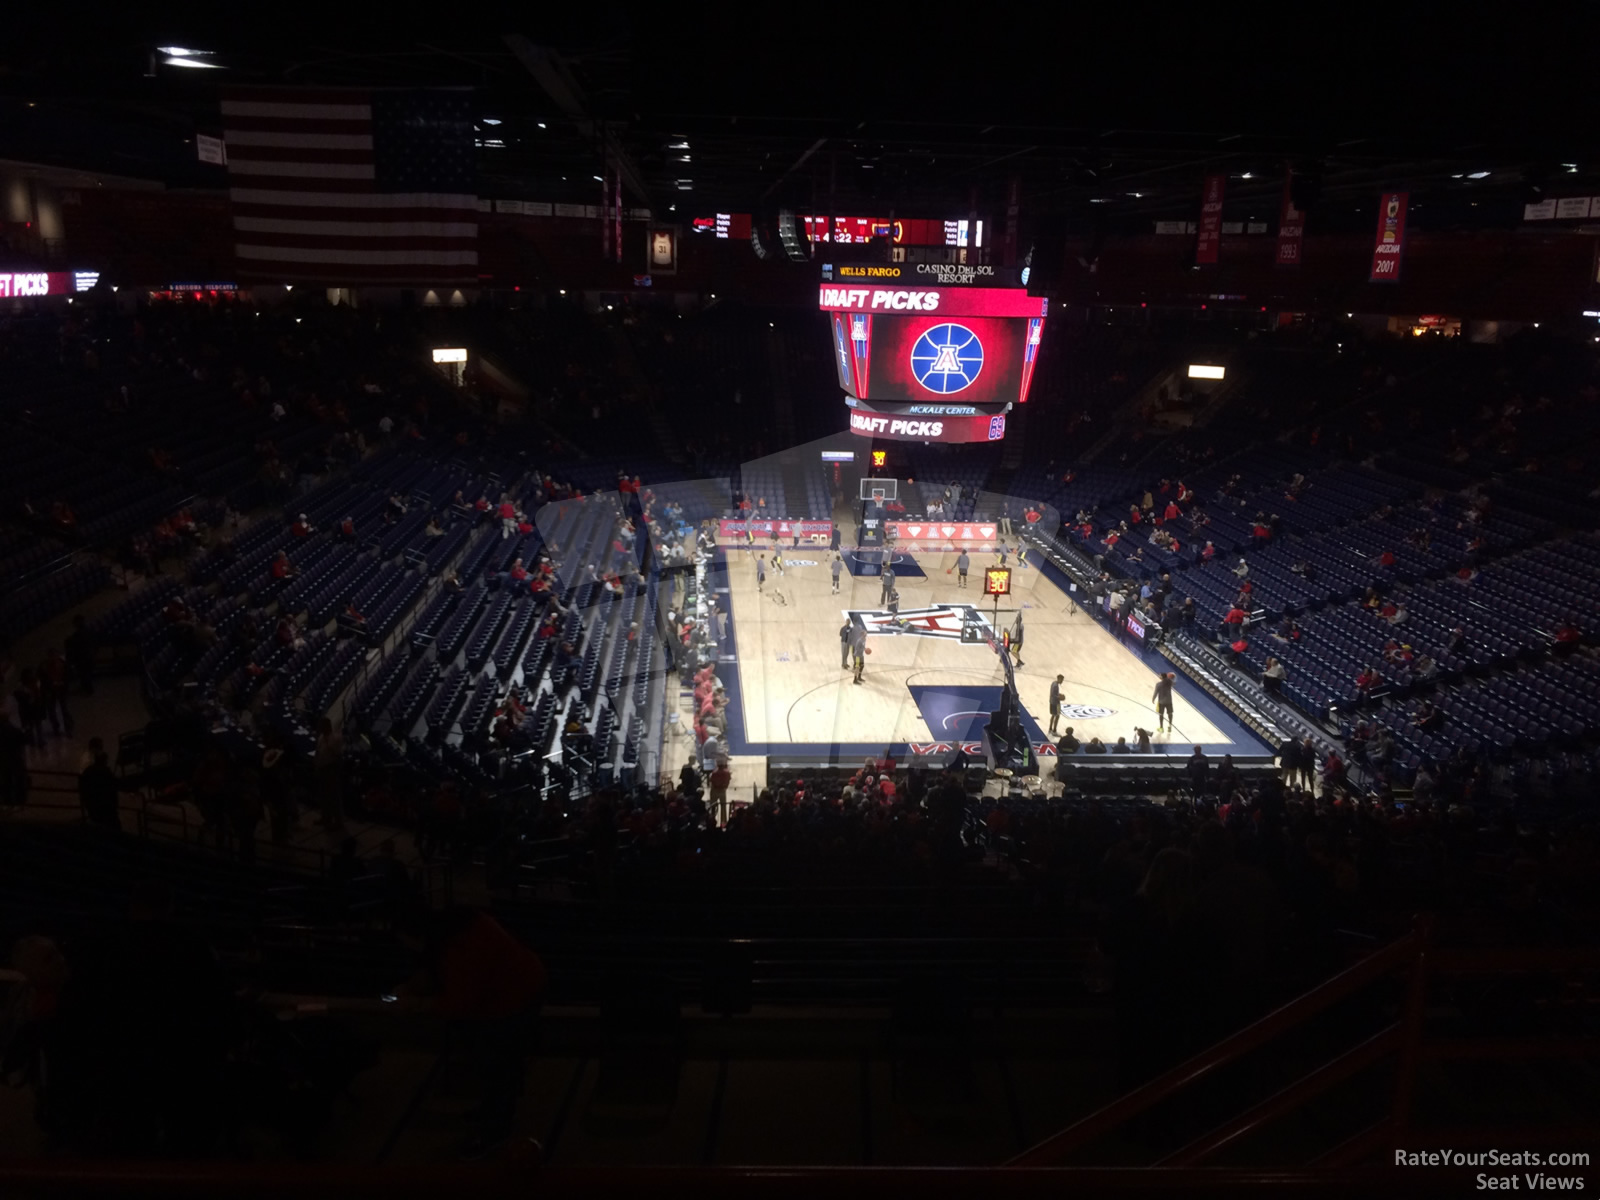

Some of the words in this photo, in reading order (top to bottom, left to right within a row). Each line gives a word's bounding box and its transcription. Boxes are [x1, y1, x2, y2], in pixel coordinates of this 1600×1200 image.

[658, 245, 667, 254] 31
[1375, 244, 1400, 253] ARIZONA
[840, 266, 866, 277] WELLS
[867, 266, 901, 278] FARGO
[917, 264, 956, 274] CASINO
[957, 265, 978, 275] DEL
[977, 266, 995, 276] SOL
[1375, 260, 1395, 273] 2001
[13, 272, 49, 296] PICKS
[937, 274, 976, 284] RESORT
[824, 289, 869, 308] DRAFT
[871, 290, 940, 311] PICKS
[930, 344, 963, 373] A
[909, 406, 944, 415] MCKALE
[946, 406, 976, 415] CENTER
[852, 414, 889, 432] DRAFT
[890, 419, 944, 437] PICKS
